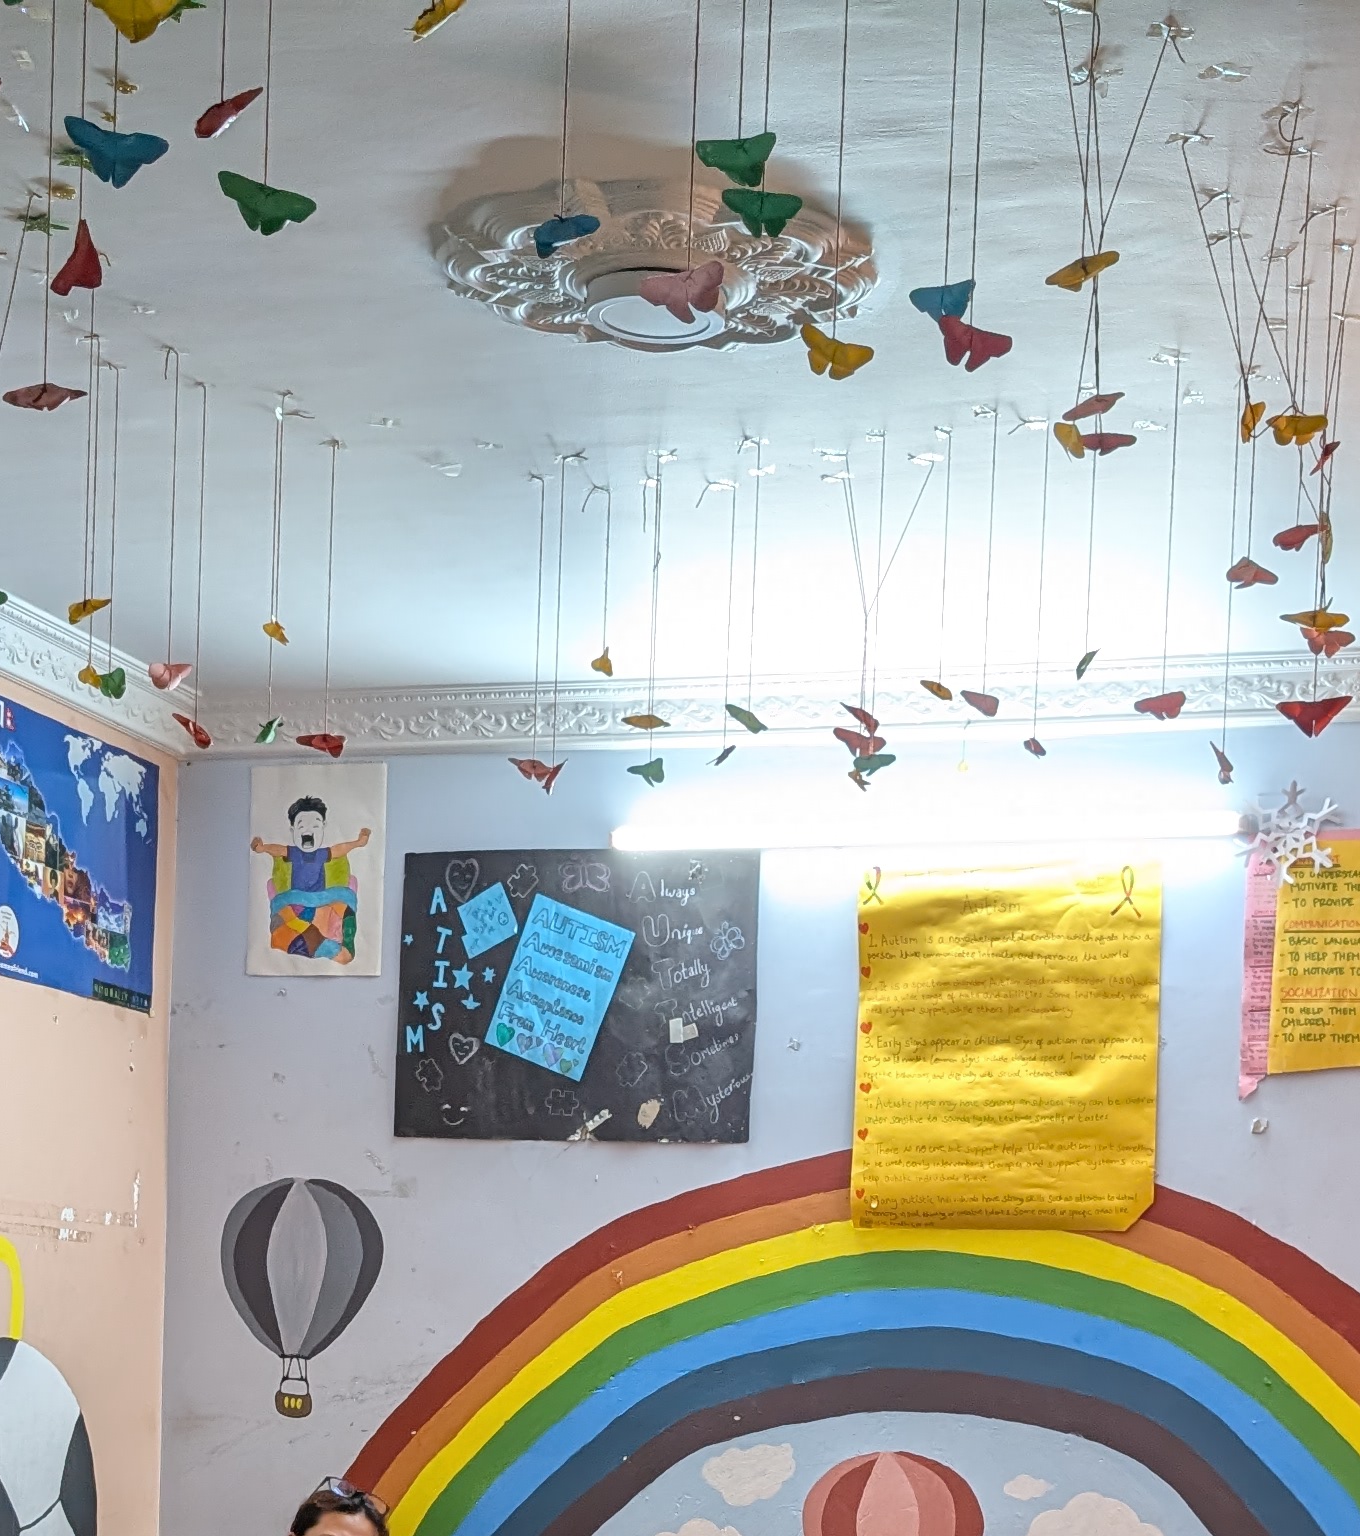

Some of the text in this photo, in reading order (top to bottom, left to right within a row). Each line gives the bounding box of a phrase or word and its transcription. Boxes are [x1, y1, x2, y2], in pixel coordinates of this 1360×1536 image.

[1293, 871, 1305, 879] TO
[626, 870, 696, 906] Always
[1290, 882, 1338, 893] MOTIVATE
[960, 894, 1021, 916] Autism
[1292, 898, 1306, 908] TO
[1313, 898, 1354, 907] PROVIDE
[532, 907, 627, 959] AUTISM
[642, 914, 704, 948] Unique
[881, 933, 918, 947] Autism
[924, 935, 933, 944] is
[1288, 936, 1318, 946] BASIC
[1288, 951, 1299, 962] TO
[1304, 951, 1328, 961] HELP
[1333, 951, 1360, 961] THEM
[651, 957, 711, 991] Totally
[1287, 967, 1298, 977] TO
[506, 979, 585, 1026] Acceptance
[654, 997, 739, 1028] Intelligent
[1283, 1006, 1294, 1015] TO
[1299, 1006, 1324, 1015] HELP
[1329, 1006, 1357, 1016] THEM
[497, 1000, 587, 1055] From Heart
[1282, 1033, 1294, 1043] TO
[1299, 1033, 1326, 1042] HELP
[1330, 1033, 1360, 1043] THEM
[665, 1032, 739, 1076] Sometimes
[876, 1035, 901, 1056] Early
[930, 1037, 960, 1052] appear
